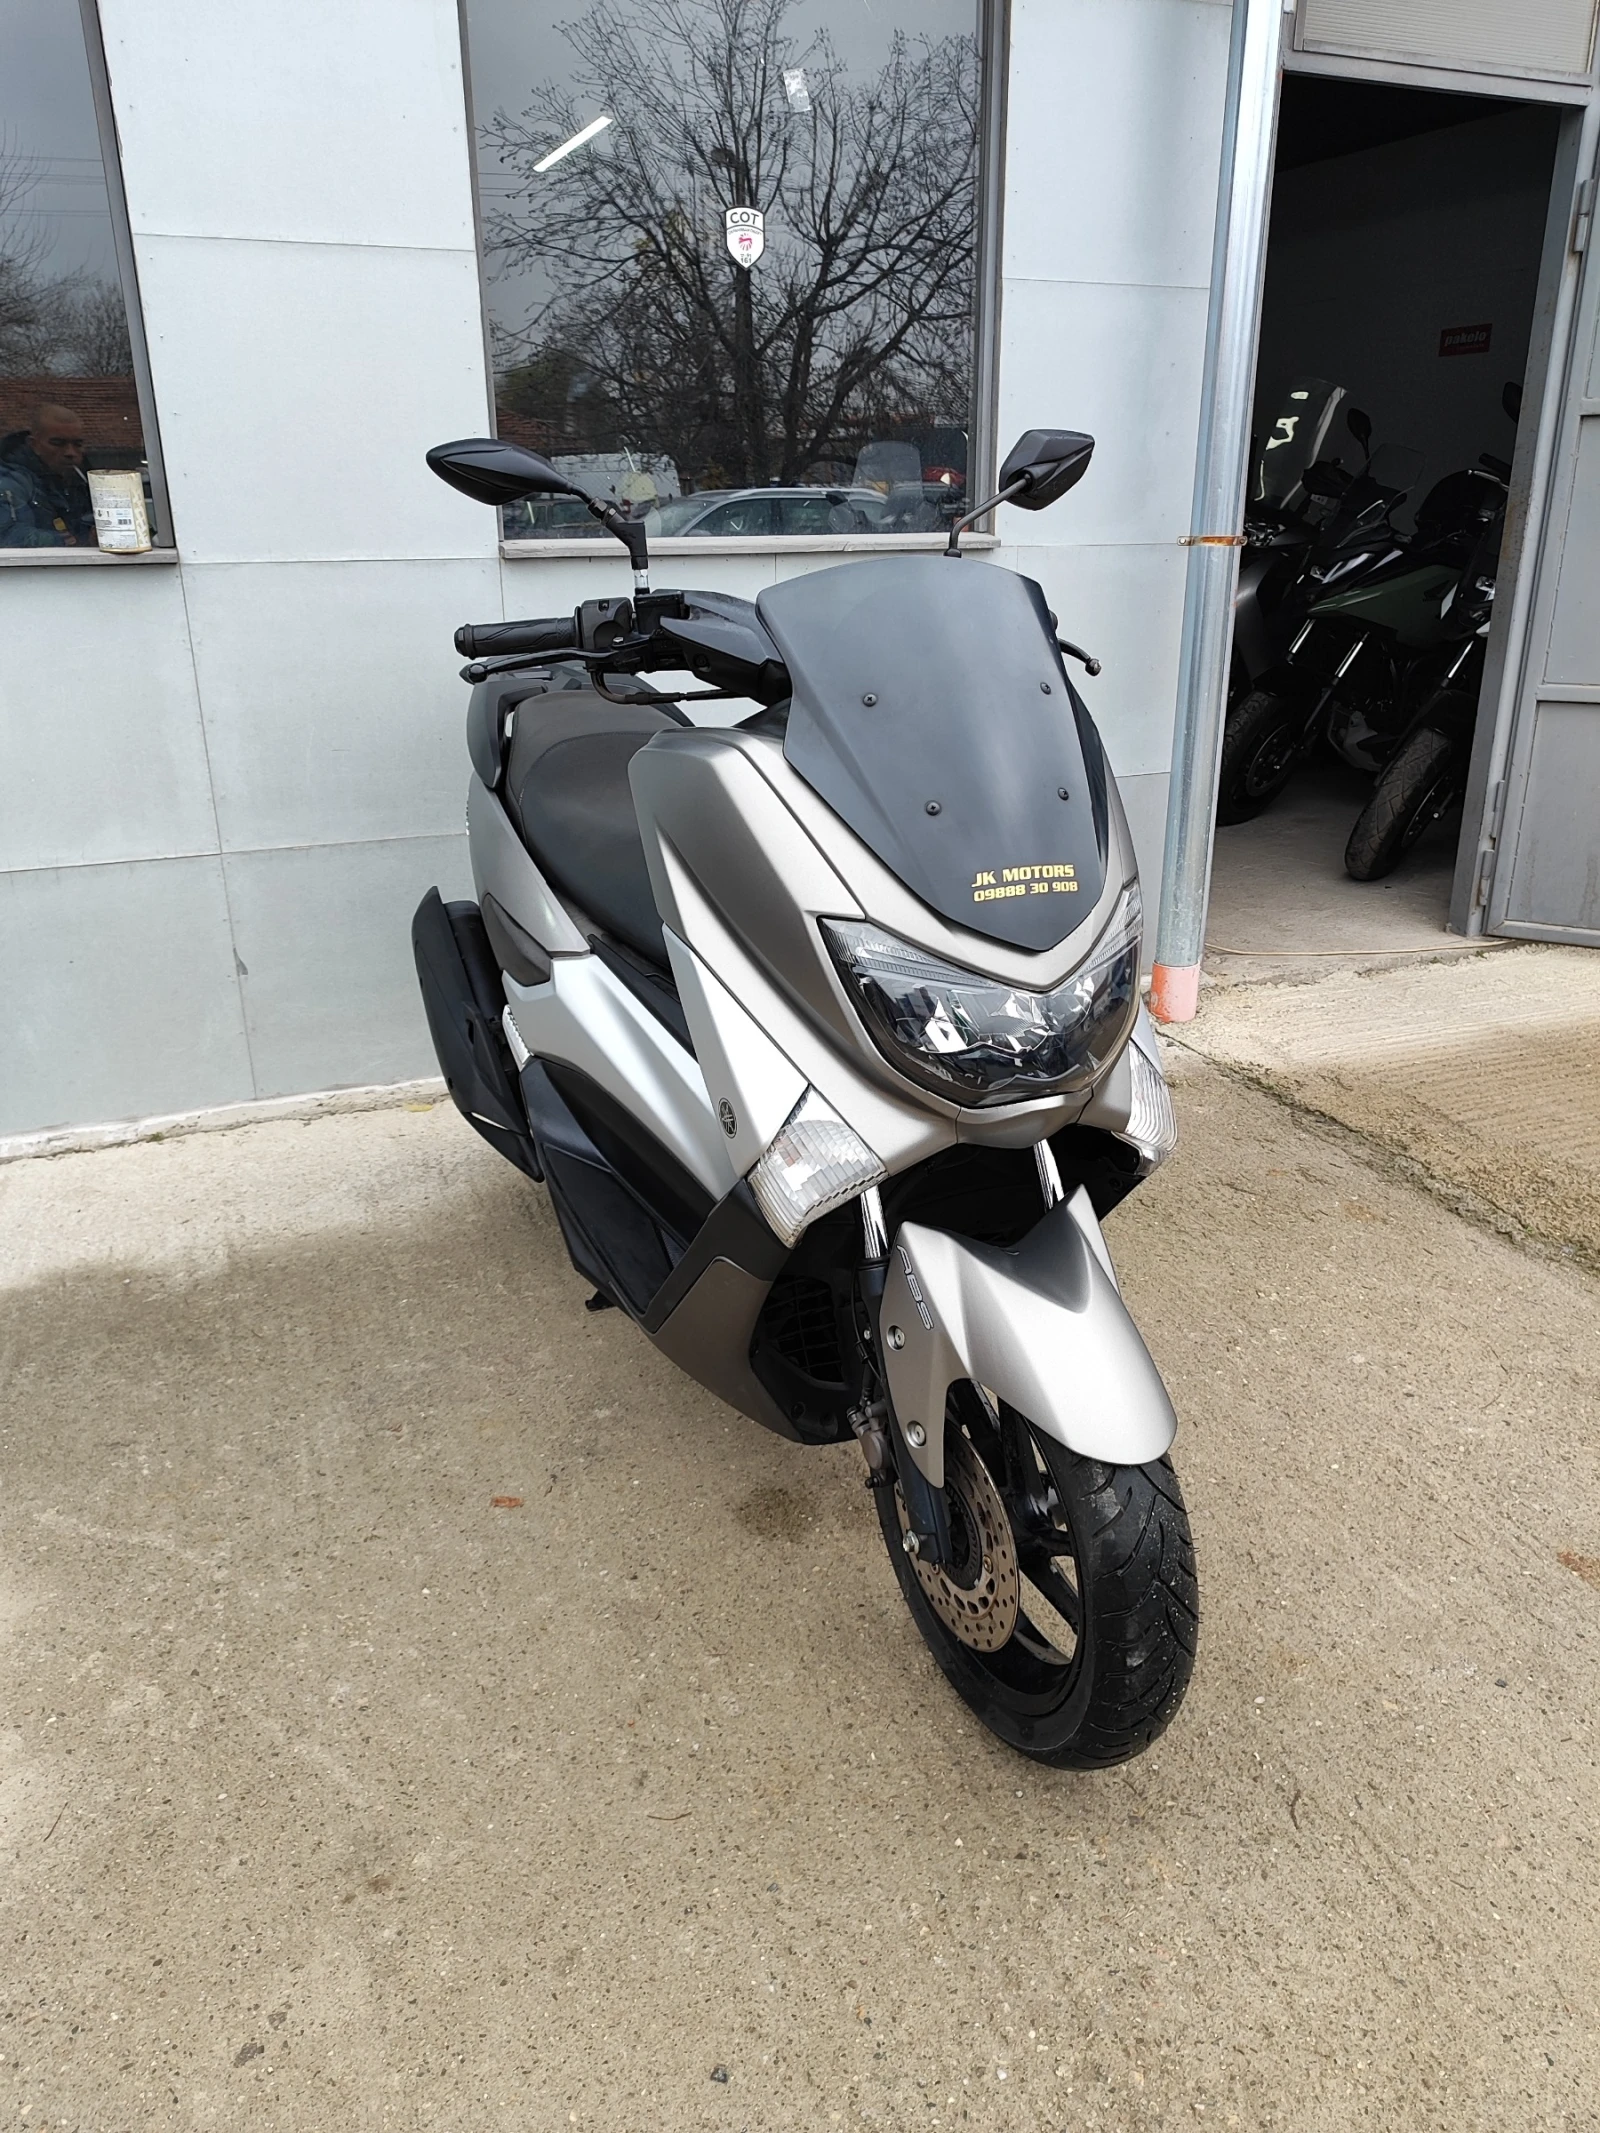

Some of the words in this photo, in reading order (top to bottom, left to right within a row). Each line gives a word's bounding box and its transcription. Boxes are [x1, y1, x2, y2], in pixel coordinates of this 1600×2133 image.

[971, 870, 997, 888] JK
[1002, 864, 1075, 882] MOTORS
[973, 884, 1026, 902] 09888
[1029, 882, 1049, 895] 30
[1051, 881, 1078, 892] 908
